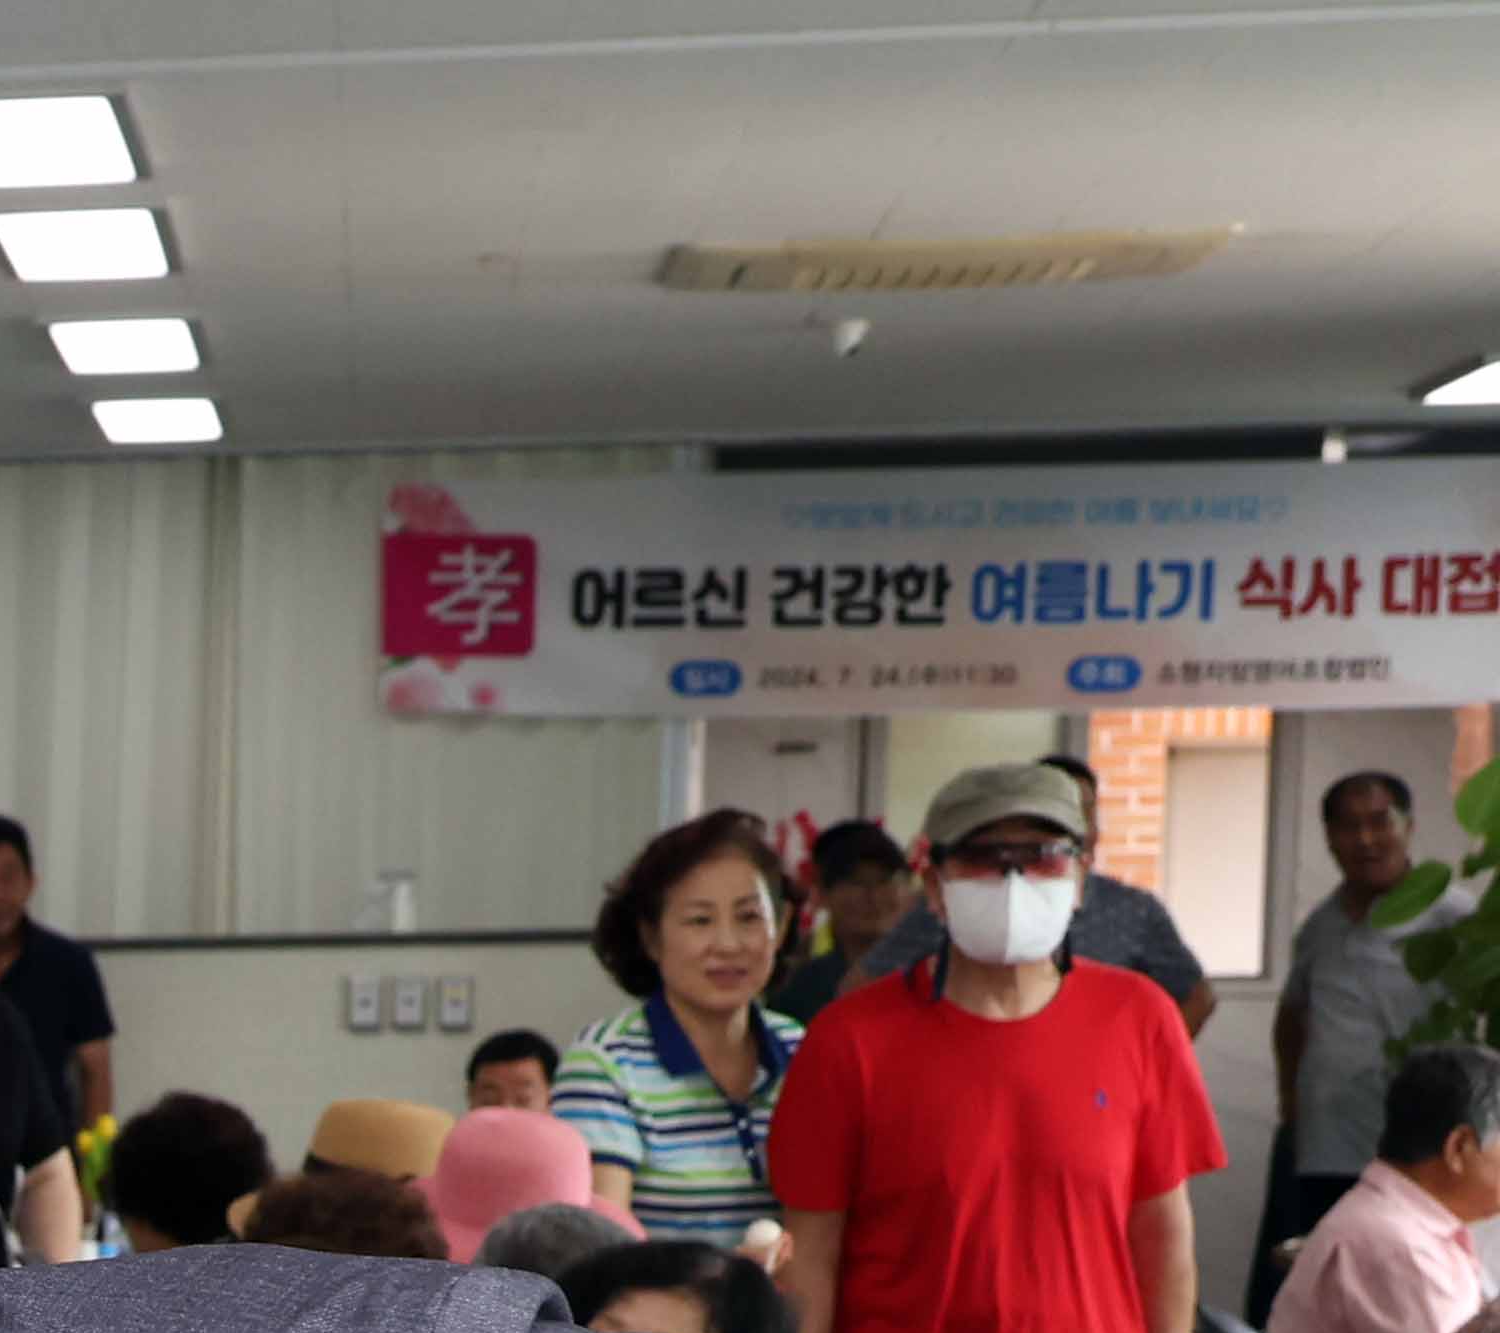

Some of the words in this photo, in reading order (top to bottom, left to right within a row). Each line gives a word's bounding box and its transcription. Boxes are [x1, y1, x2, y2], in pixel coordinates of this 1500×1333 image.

[426, 545, 523, 646] 孝
[572, 564, 750, 629] 어르신
[770, 561, 953, 628] 건강한
[970, 558, 1217, 624] 여름나기
[1236, 554, 1363, 620] 식사
